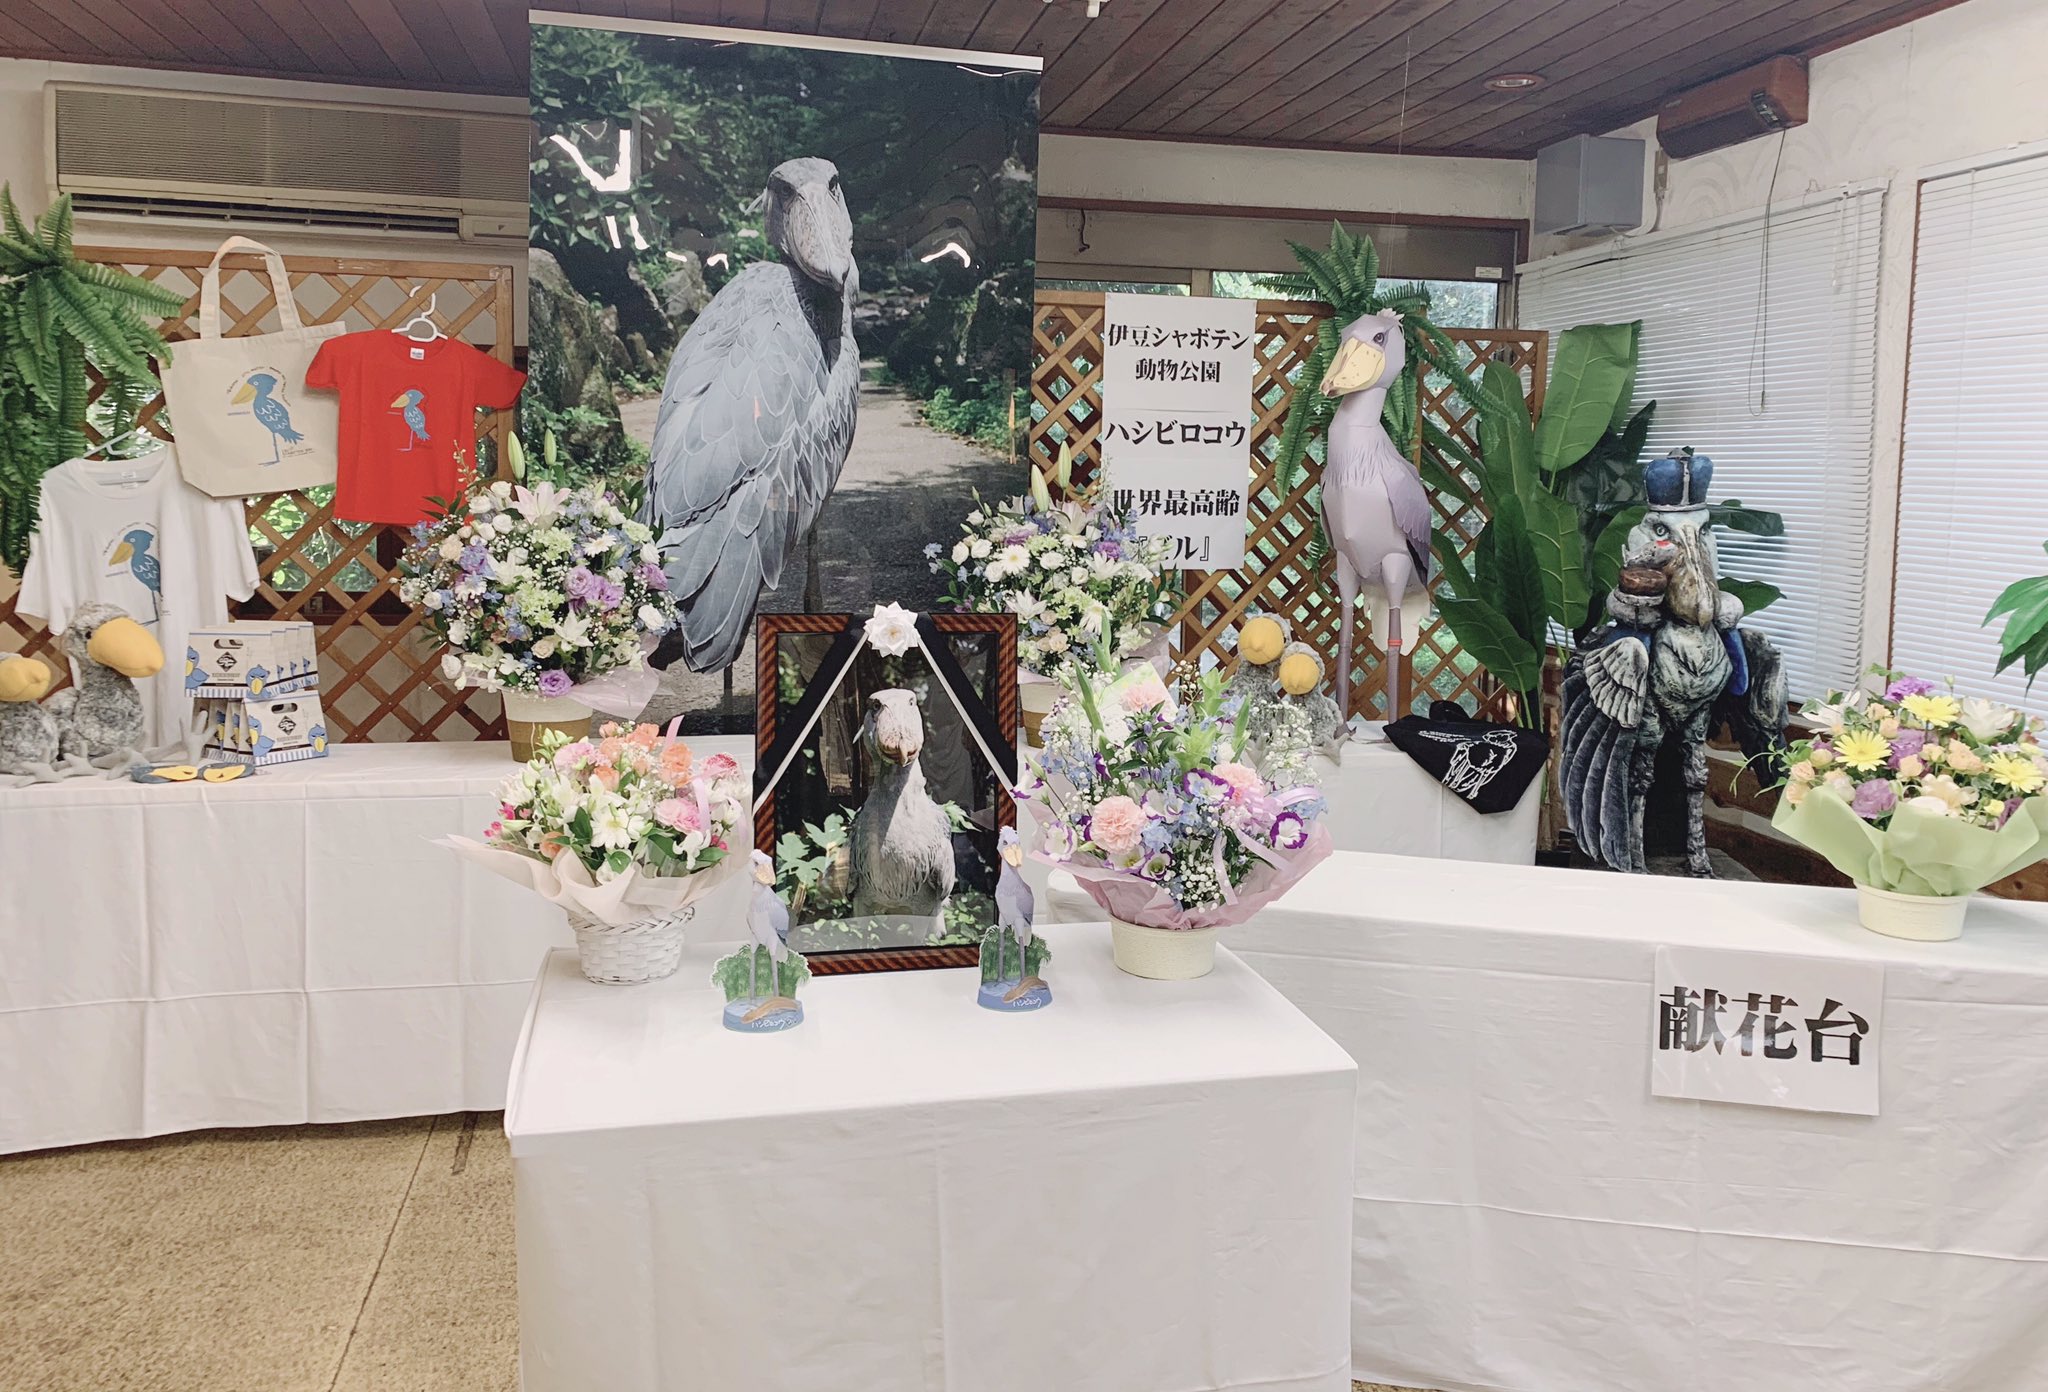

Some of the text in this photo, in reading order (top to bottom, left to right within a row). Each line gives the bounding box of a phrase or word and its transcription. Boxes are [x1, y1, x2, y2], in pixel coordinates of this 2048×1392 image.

[1108, 324, 1250, 351] 伊豆シャボテン
[1135, 358, 1222, 383] 動物公園
[1104, 420, 1246, 447] ハシビロコウ
[1112, 489, 1241, 517] 世界最高齢
[1658, 985, 1870, 1066] 献花台
